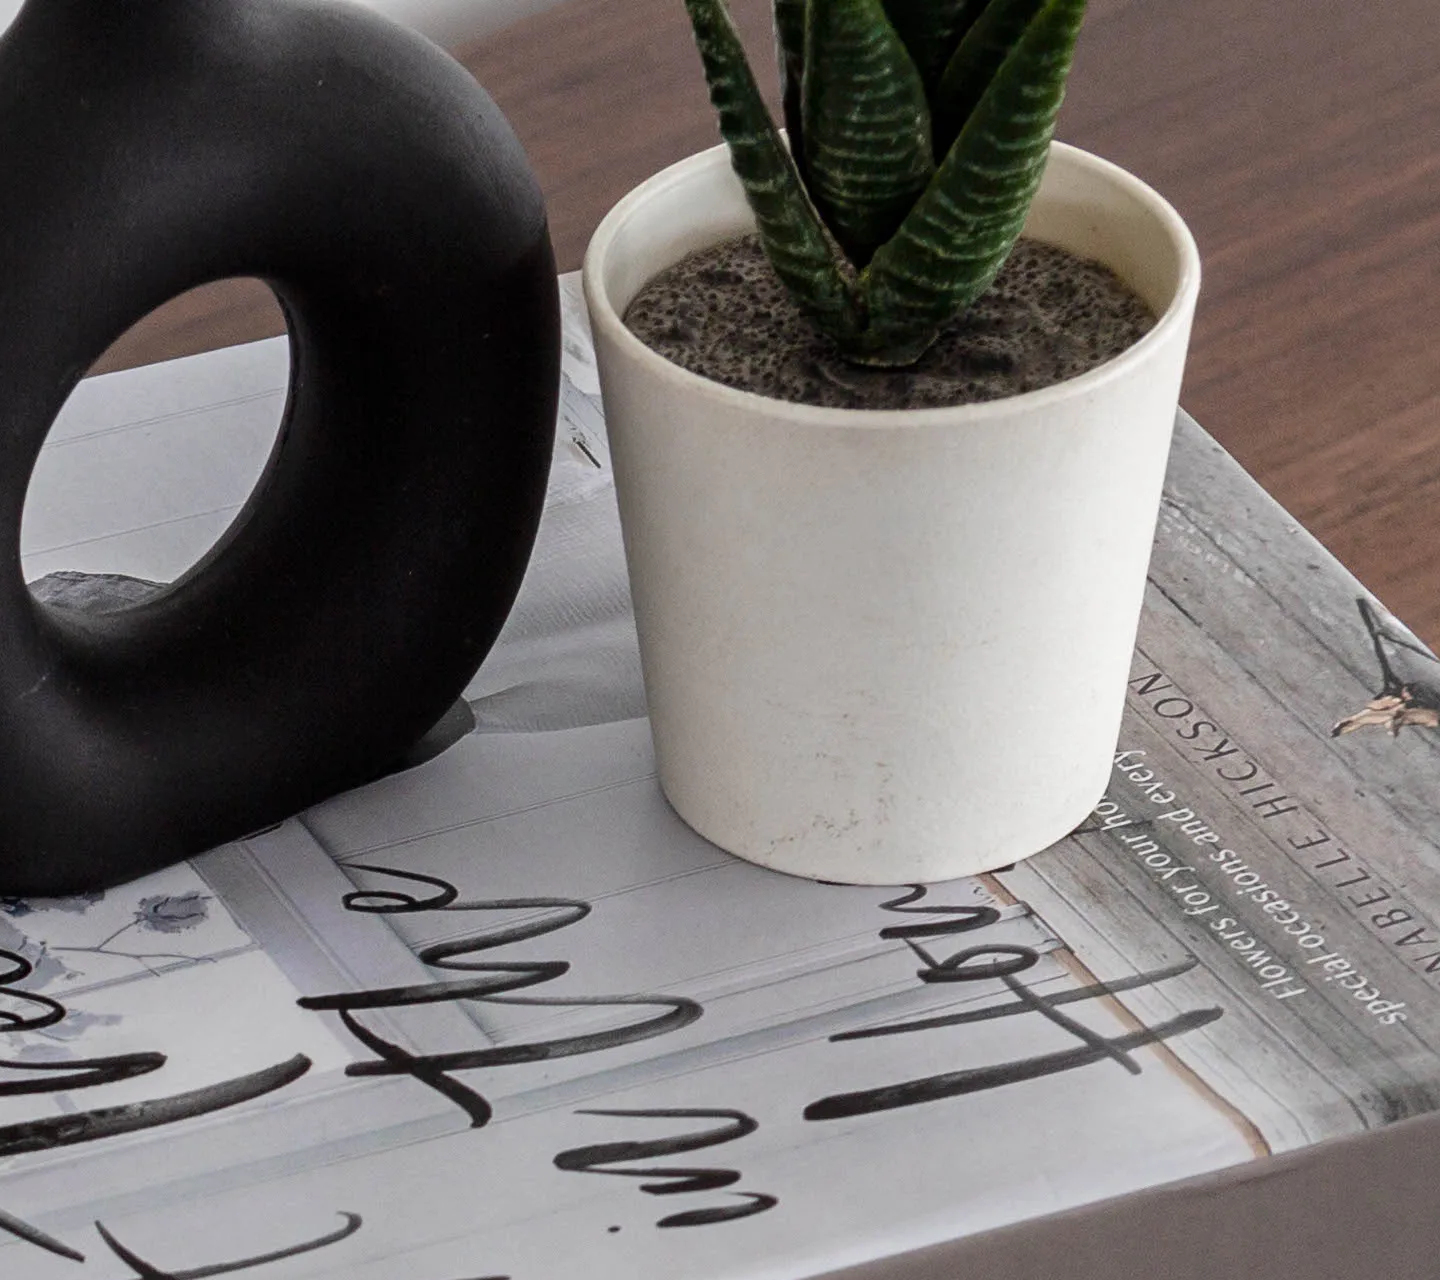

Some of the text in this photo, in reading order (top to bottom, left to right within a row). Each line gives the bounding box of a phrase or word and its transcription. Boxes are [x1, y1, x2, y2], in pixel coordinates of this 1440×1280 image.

[1127, 671, 1300, 820] HICKSON
[802, 882, 1225, 1121] Hou
[1092, 794, 1308, 1001] Flowers for your ho
[1113, 750, 1409, 1027] special occasions and every
[296, 861, 780, 1236] in the
